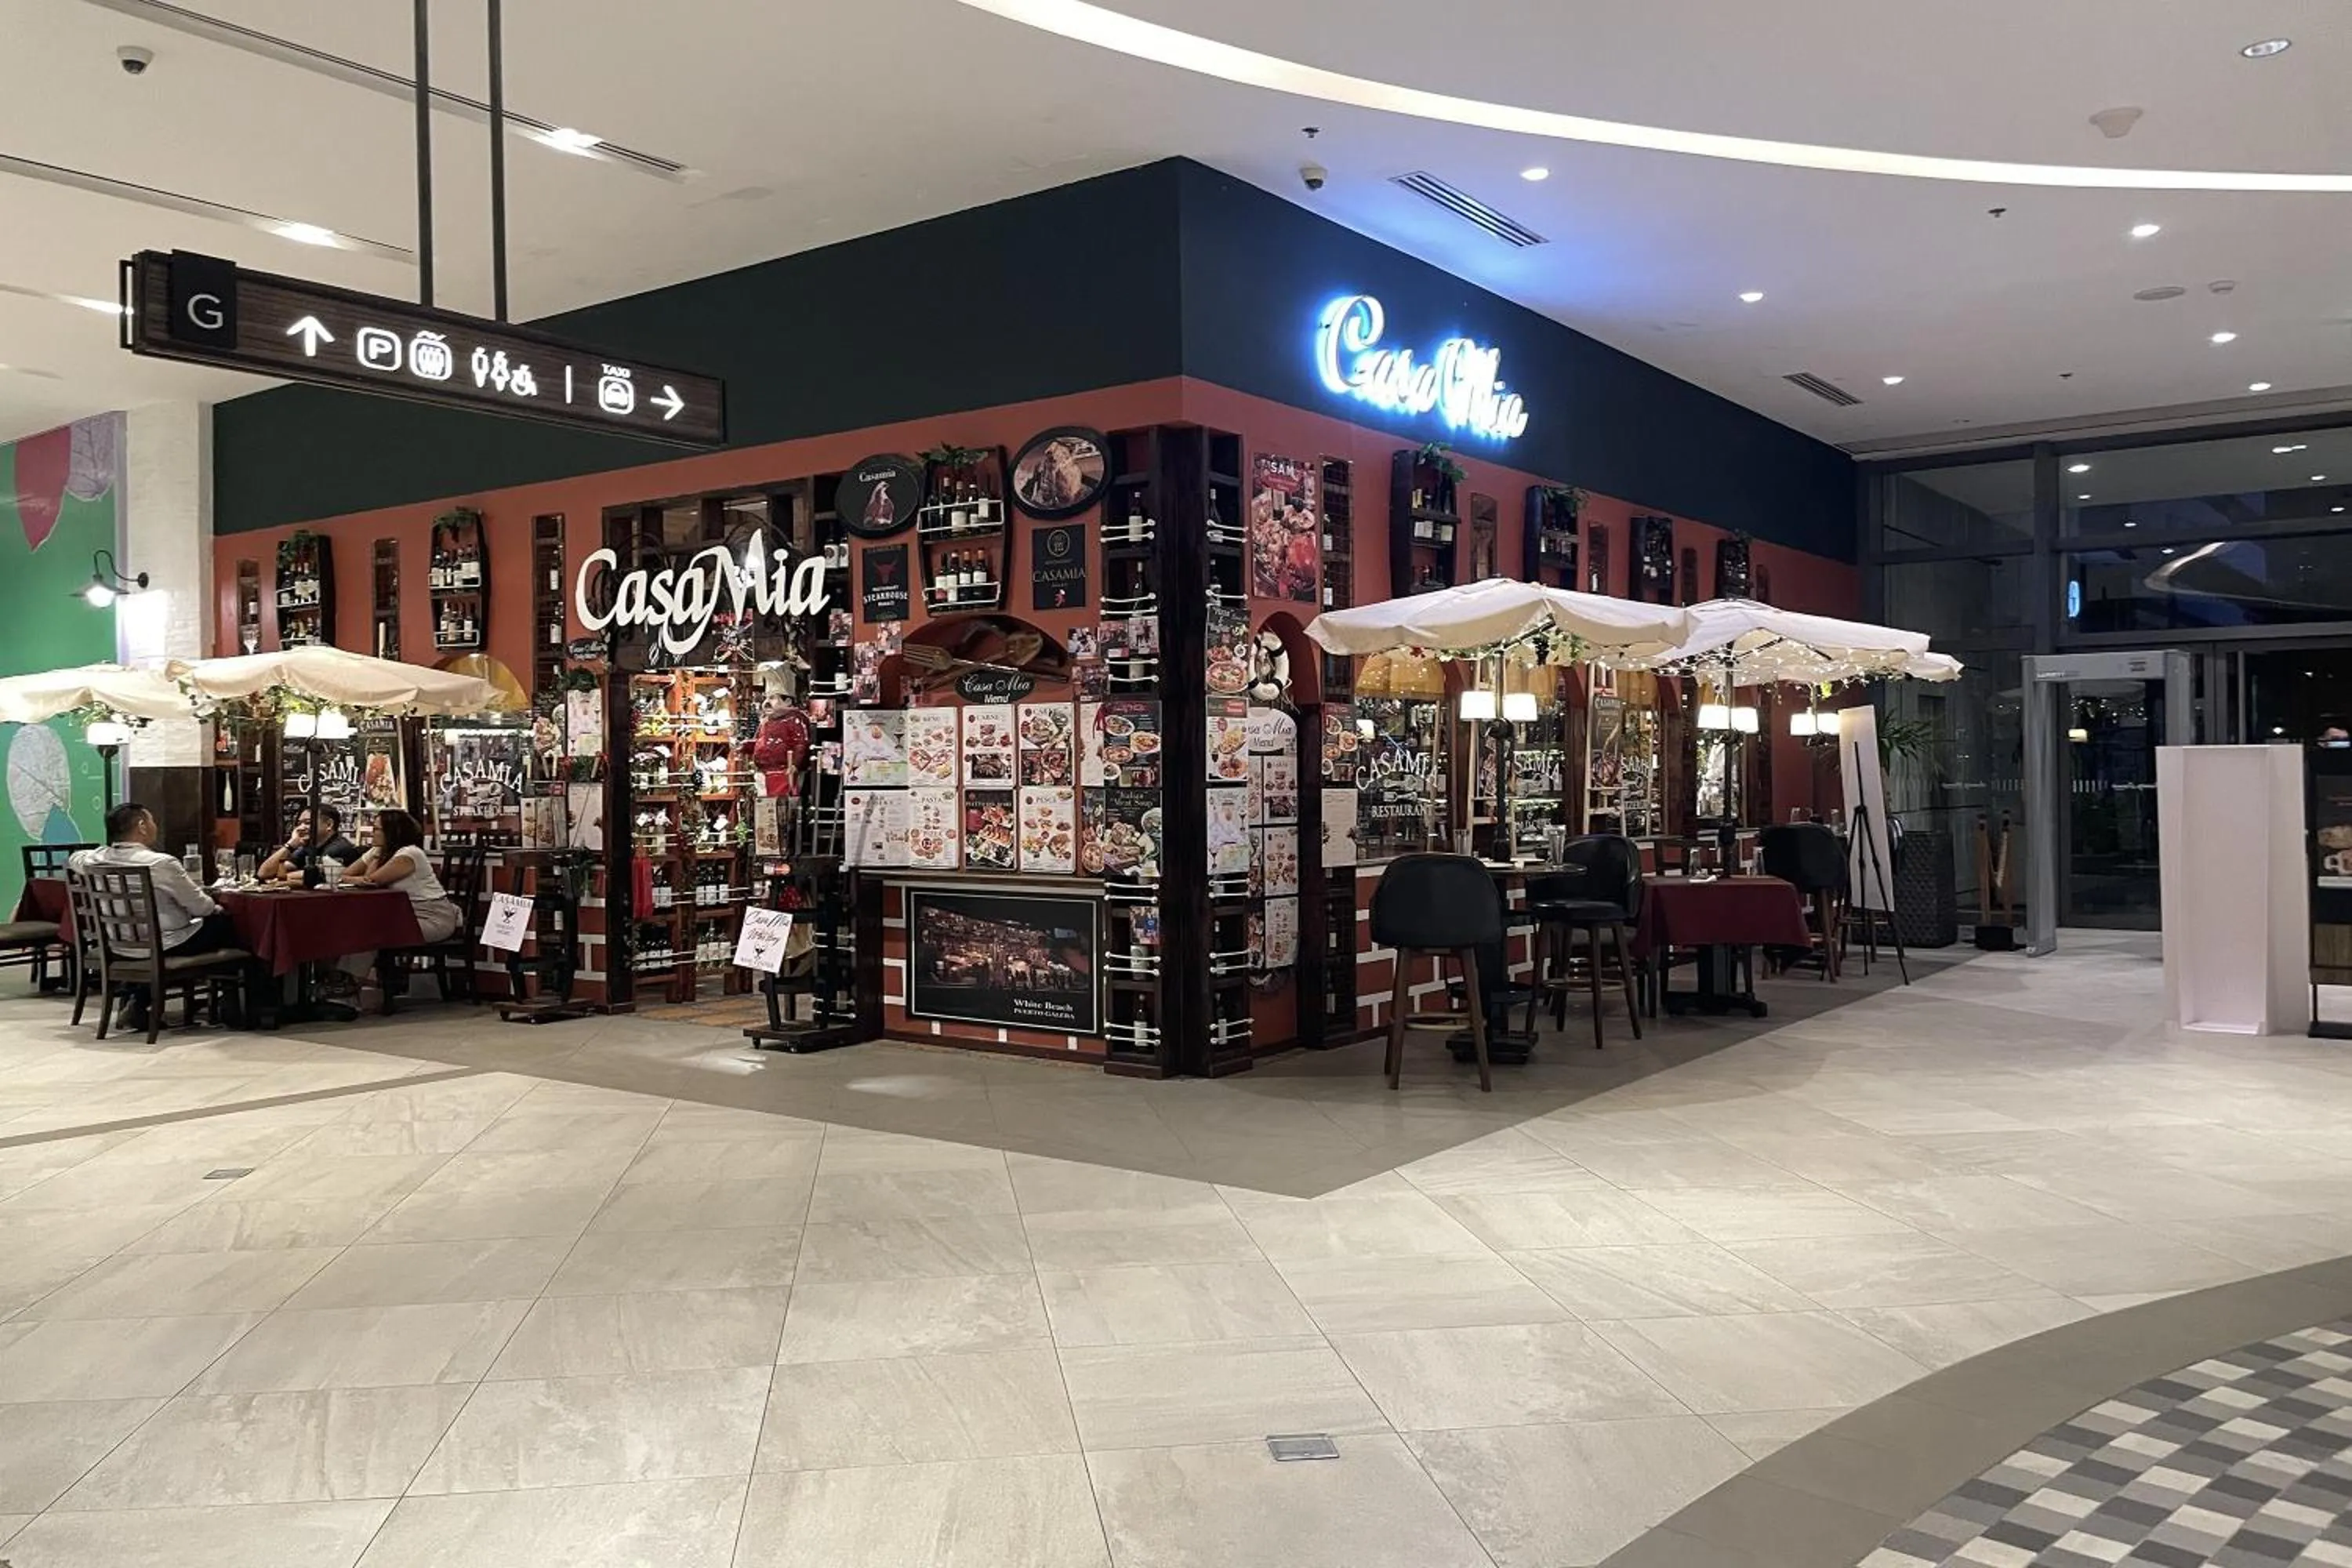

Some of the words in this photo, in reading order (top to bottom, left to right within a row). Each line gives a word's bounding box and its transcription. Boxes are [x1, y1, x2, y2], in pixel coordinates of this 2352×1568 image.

[187, 293, 223, 329] G
[601, 363, 631, 378] TAXI
[1316, 294, 1437, 413] Casa
[1436, 337, 1529, 438] Mia
[1033, 568, 1086, 583] CASAMIA
[575, 548, 708, 630] Casa
[666, 528, 830, 655] Mia
[963, 674, 993, 691] Casa
[995, 675, 1029, 691] Mia
[440, 758, 523, 794] CASAMIA
[1013, 998, 1044, 1009] White
[1044, 1001, 1073, 1012] Beach
